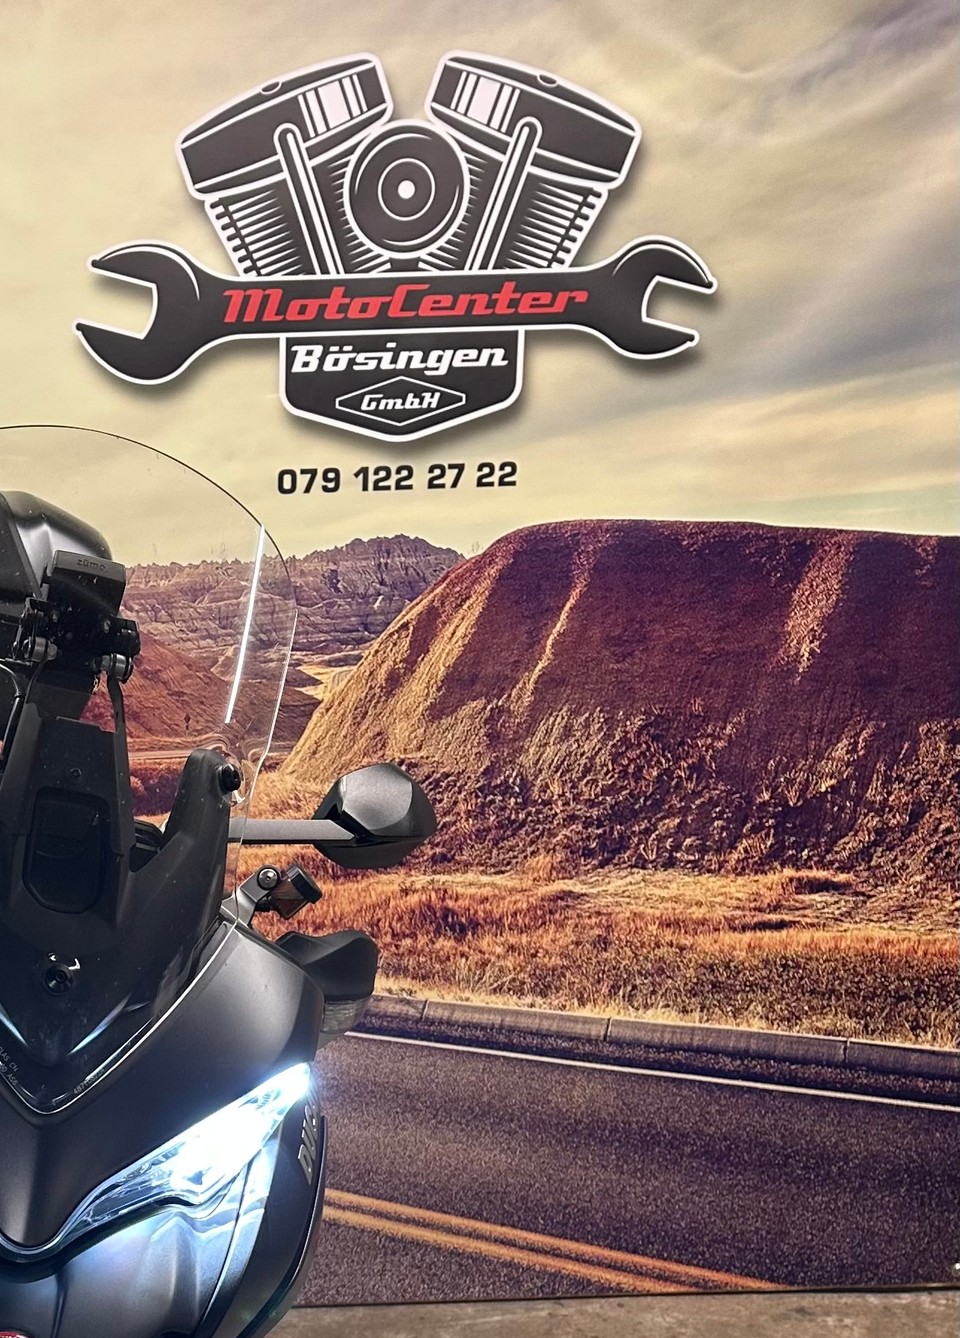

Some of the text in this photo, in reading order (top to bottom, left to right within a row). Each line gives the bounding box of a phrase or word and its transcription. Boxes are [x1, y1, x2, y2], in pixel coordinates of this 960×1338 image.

[223, 281, 589, 323] MotoCenter
[290, 342, 509, 376] Bösingen
[360, 391, 441, 411] GmbH
[277, 460, 517, 495] 079 122 27 22
